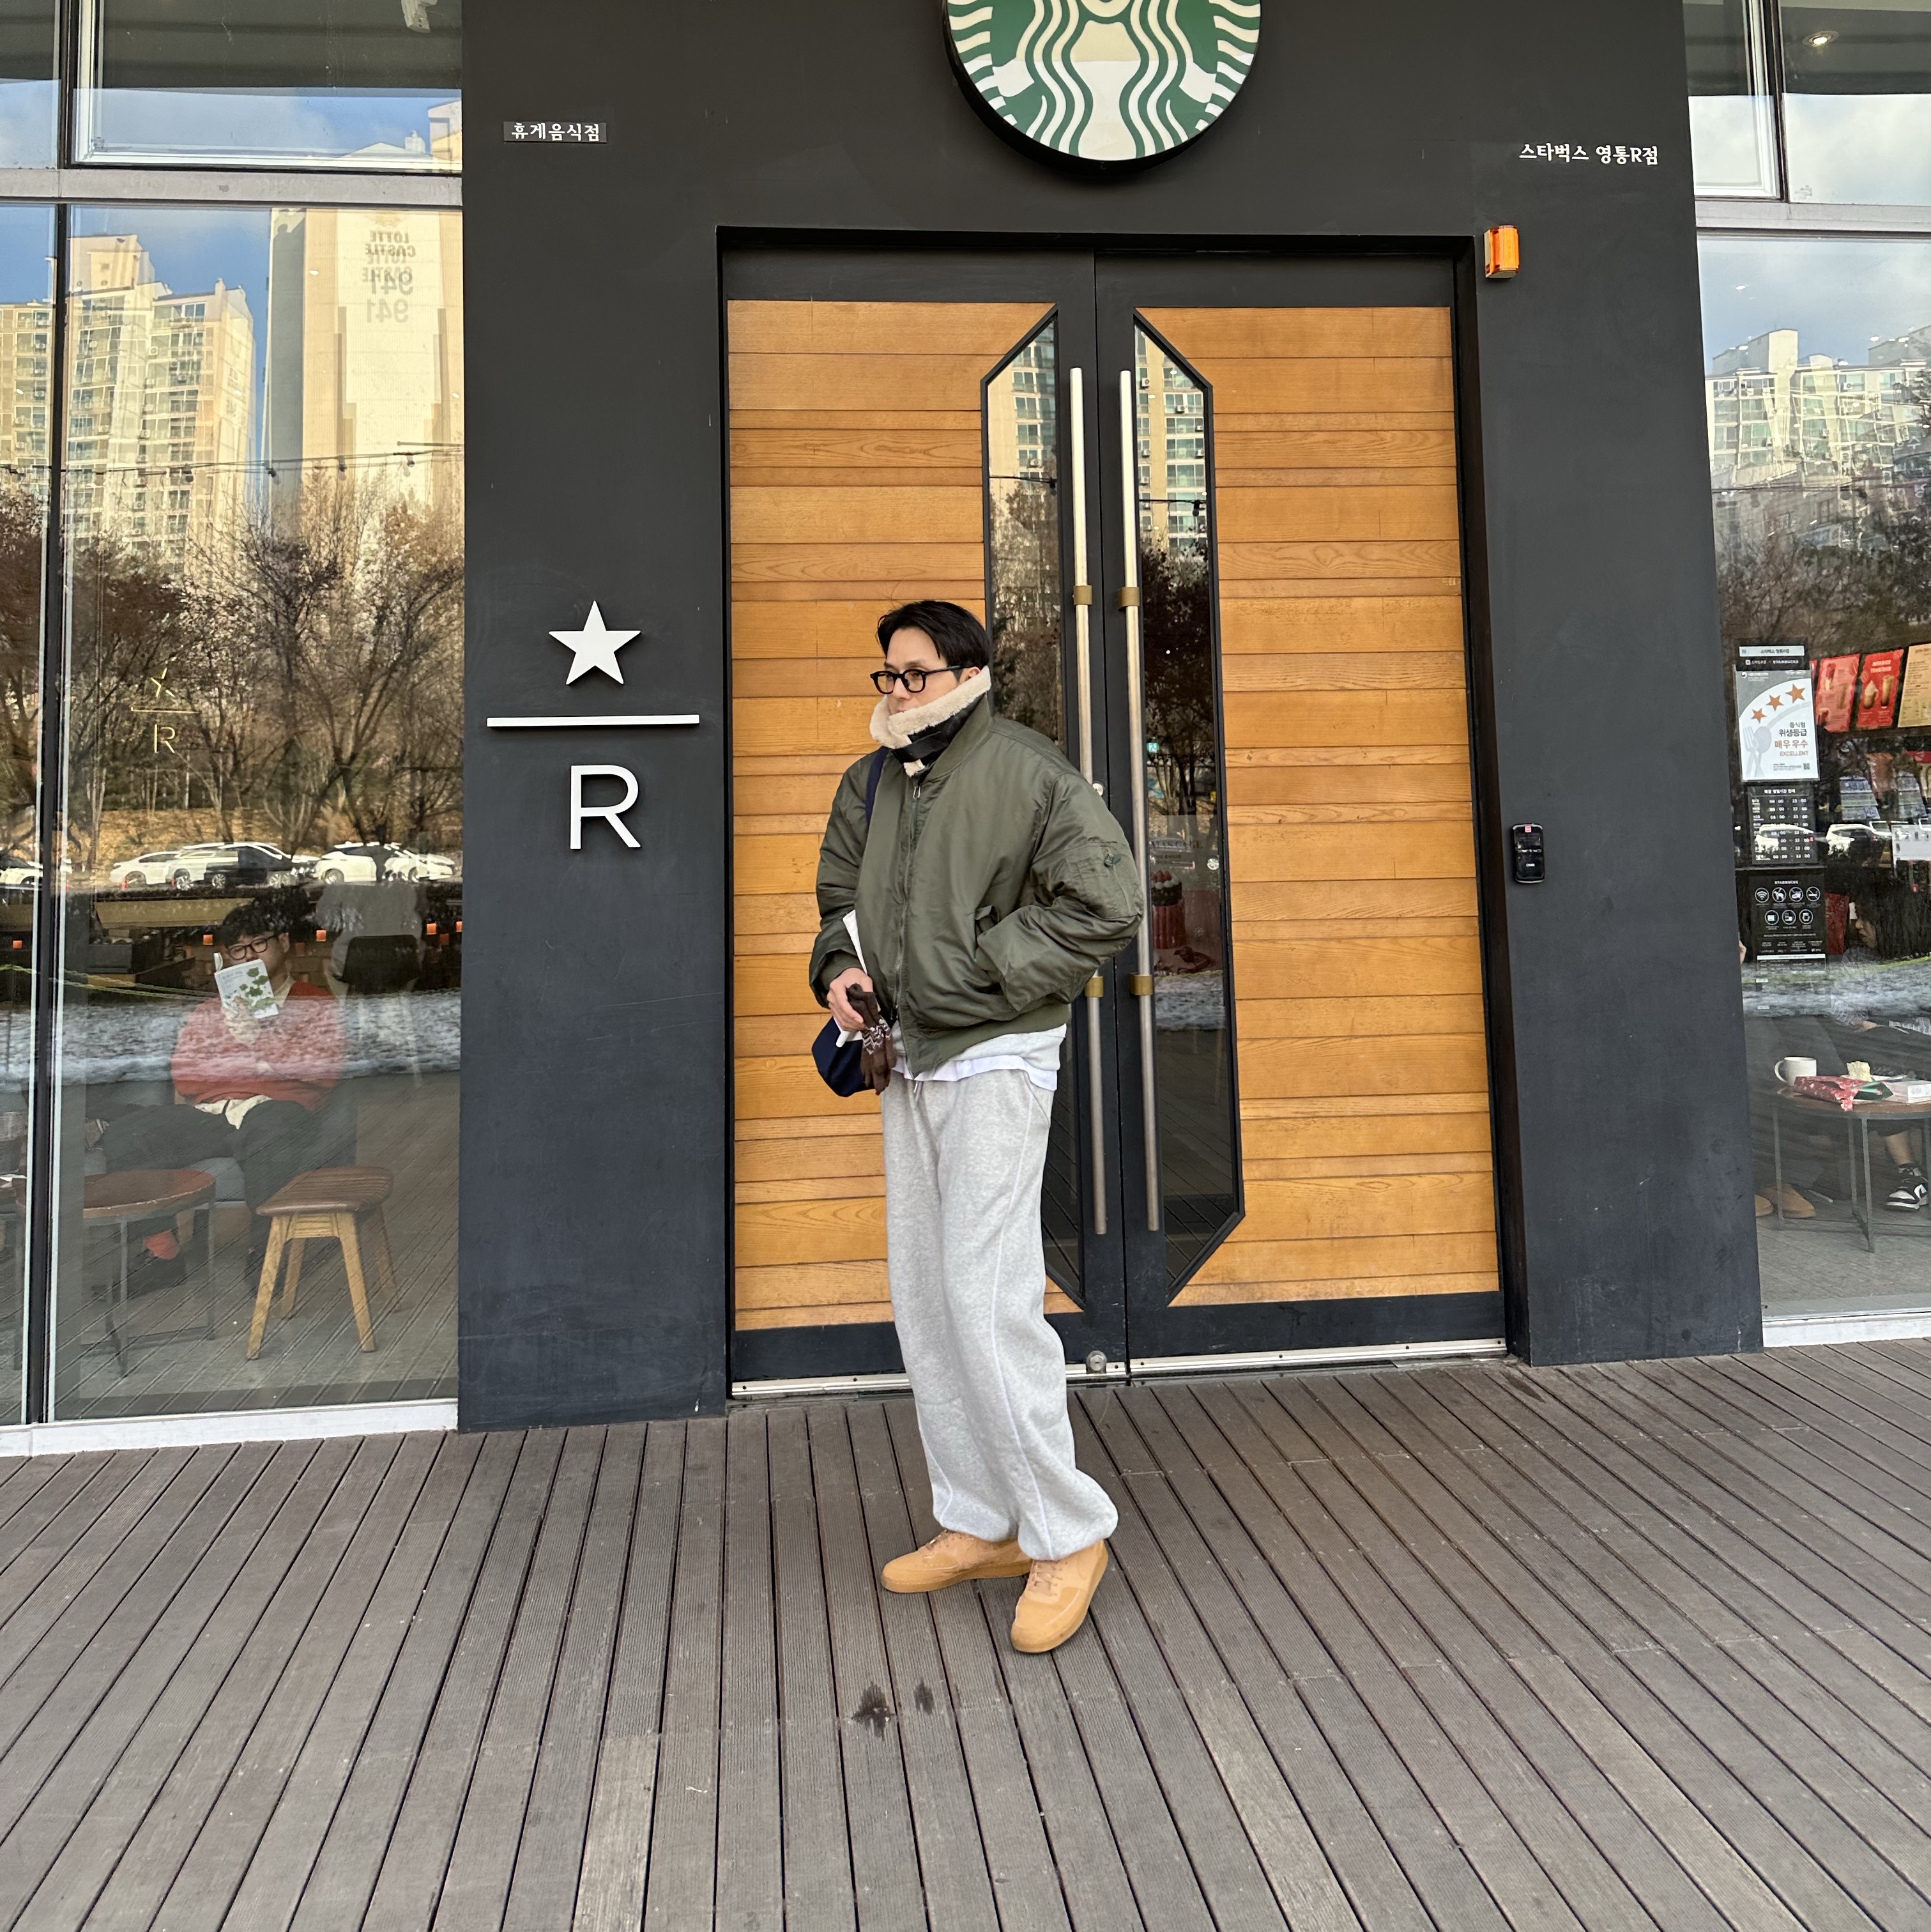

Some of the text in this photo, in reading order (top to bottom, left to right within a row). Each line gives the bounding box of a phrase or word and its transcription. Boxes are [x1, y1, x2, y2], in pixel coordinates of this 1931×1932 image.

[512, 122, 599, 142] 휴게음식점
[1519, 143, 1658, 165] 스타벅스 영통R점
[154, 724, 176, 753] R
[1779, 728, 1808, 737] 위생등급
[570, 765, 641, 850] R
